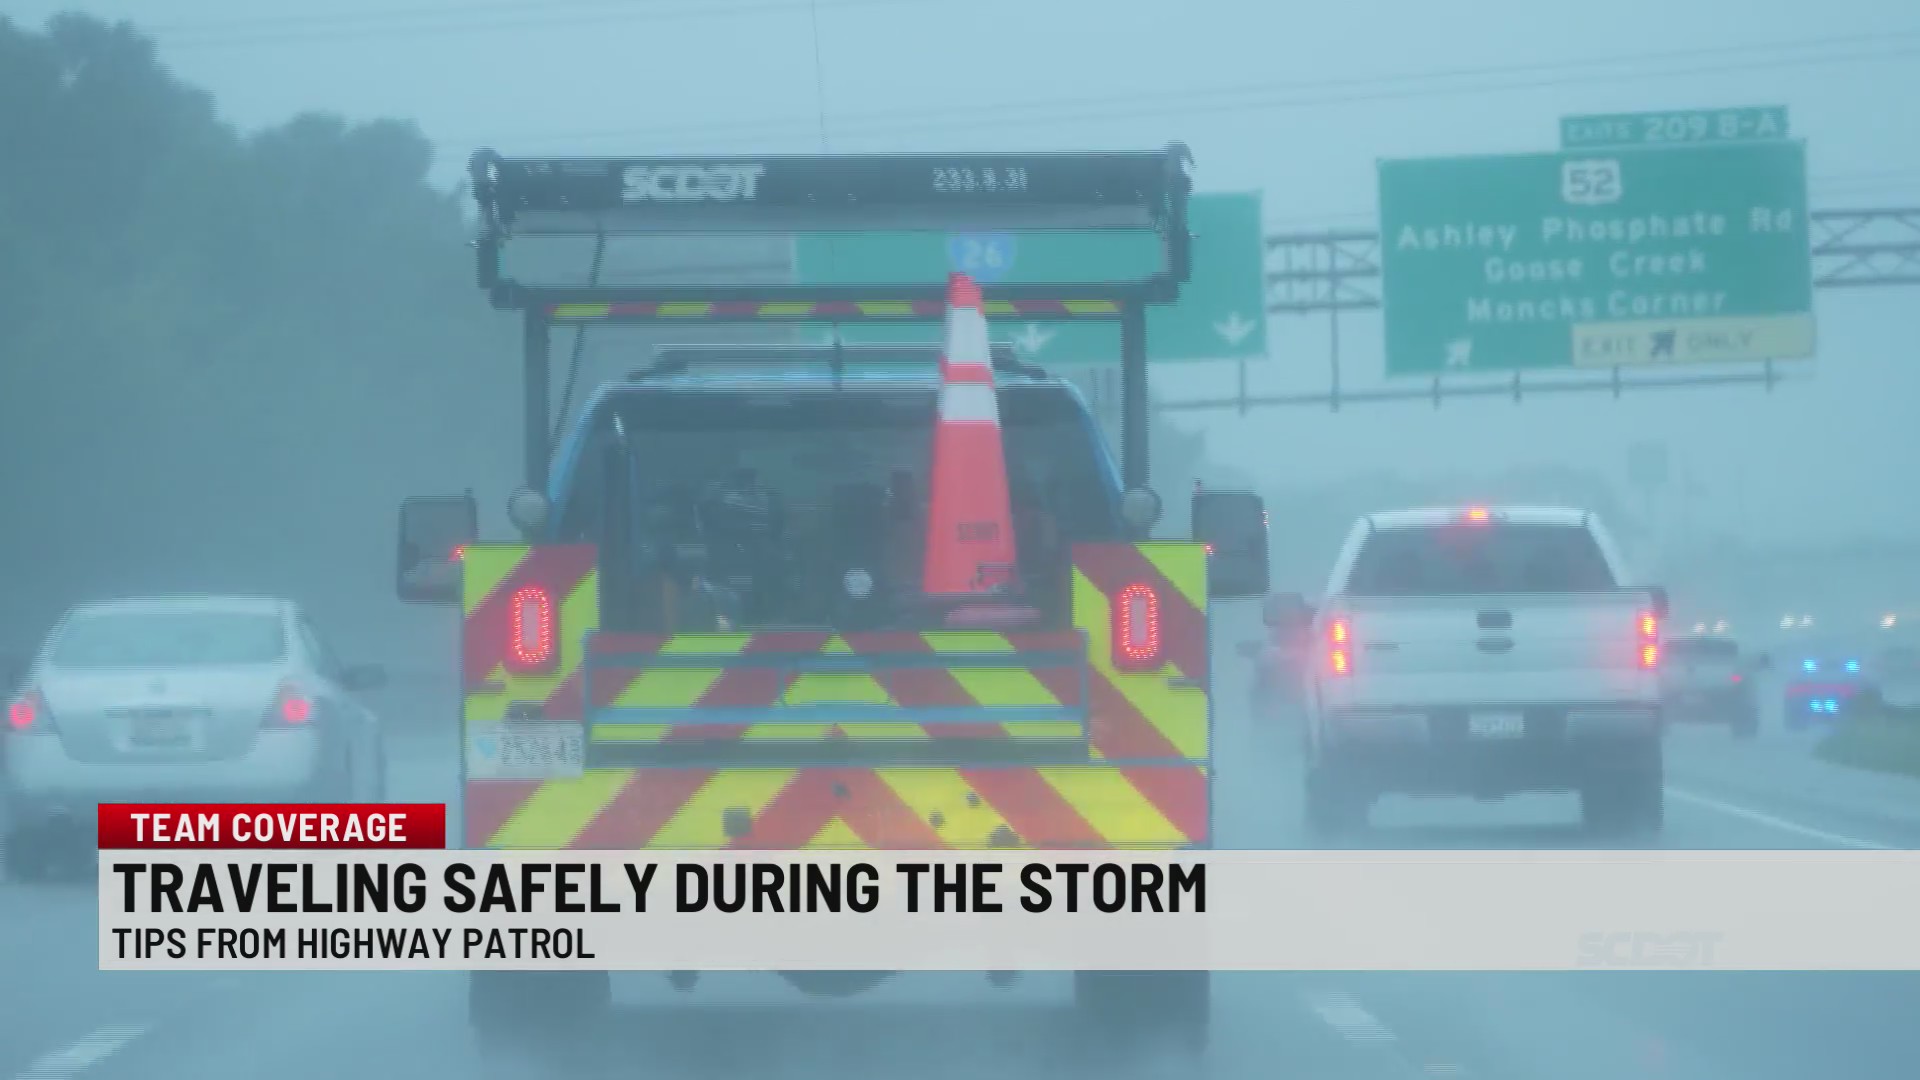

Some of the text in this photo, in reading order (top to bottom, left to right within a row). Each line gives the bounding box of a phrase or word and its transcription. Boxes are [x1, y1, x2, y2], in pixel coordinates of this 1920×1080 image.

[1644, 115, 1708, 142] 209
[621, 165, 766, 203] SCDOT
[1568, 168, 1616, 197] 52
[1397, 206, 1792, 251] Ashley Phosphate Rd
[961, 240, 1003, 269] 26
[1484, 249, 1707, 283] Goose Creek
[1467, 290, 1727, 323] Moncks Corner
[1581, 328, 1755, 355] EXIT ONLY
